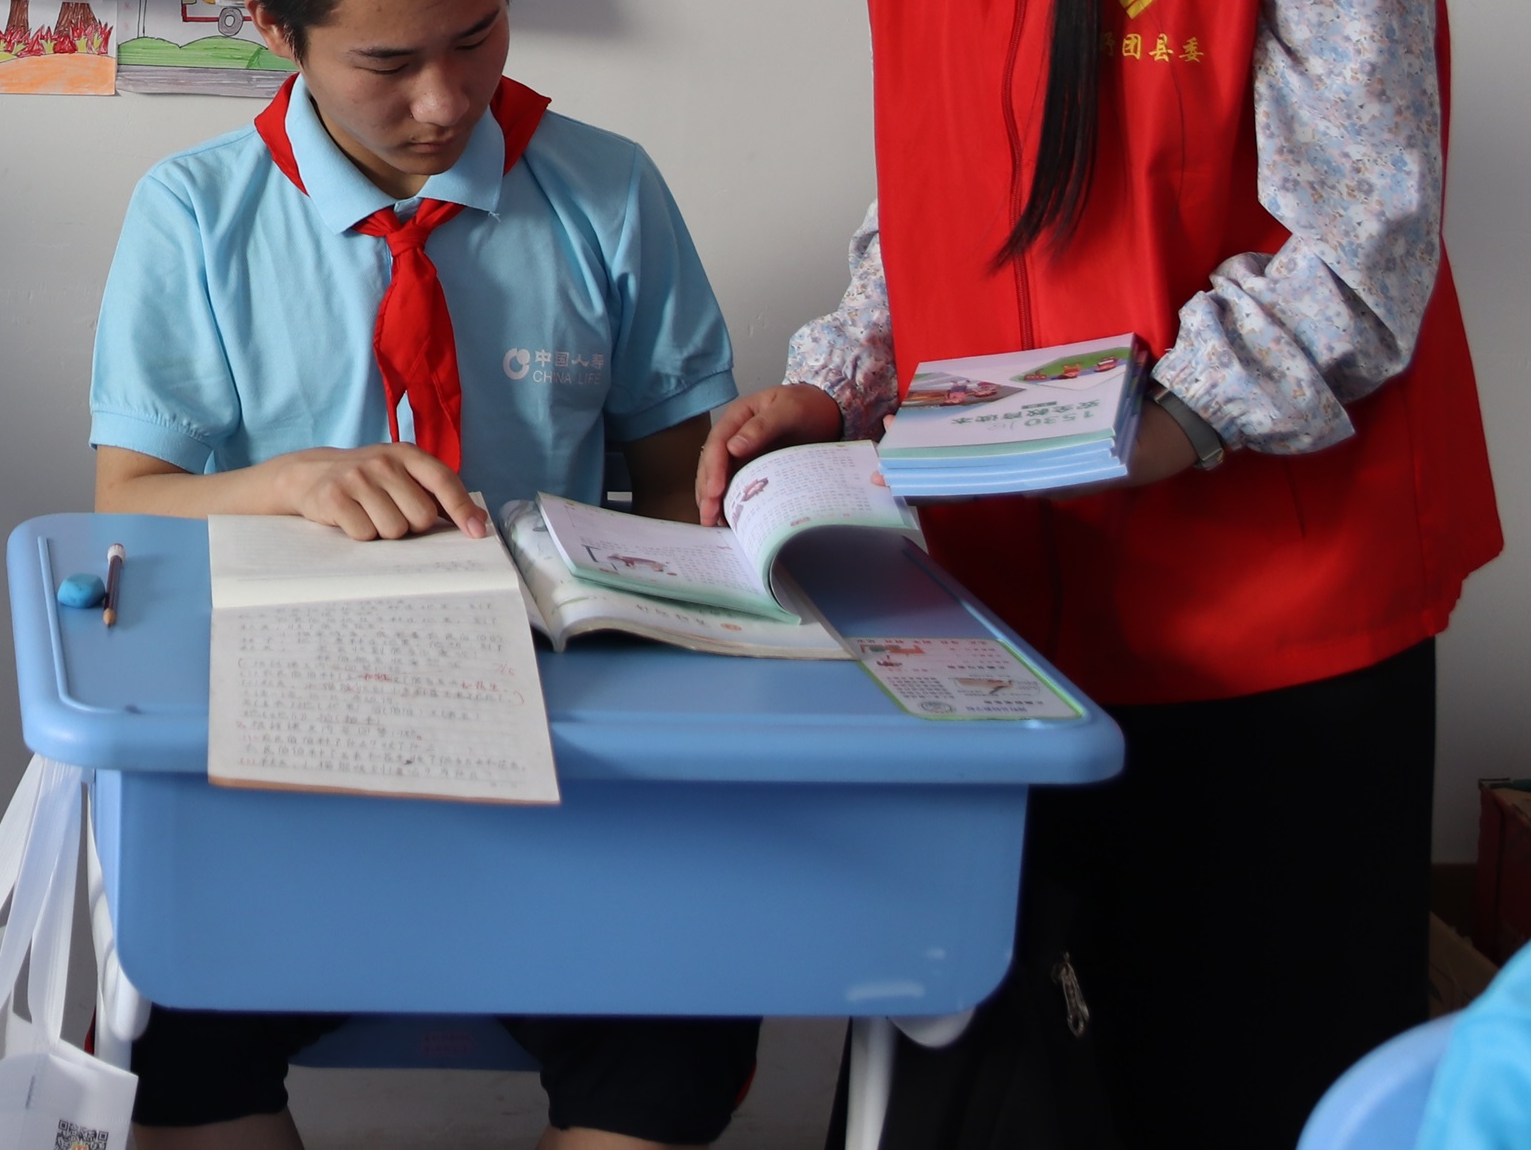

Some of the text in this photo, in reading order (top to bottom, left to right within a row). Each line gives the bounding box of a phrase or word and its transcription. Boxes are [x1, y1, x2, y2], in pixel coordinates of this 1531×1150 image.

[535, 348, 605, 370] 中国人寿
[533, 370, 602, 385] CHINA LIFE
[1023, 409, 1095, 427] 1530
